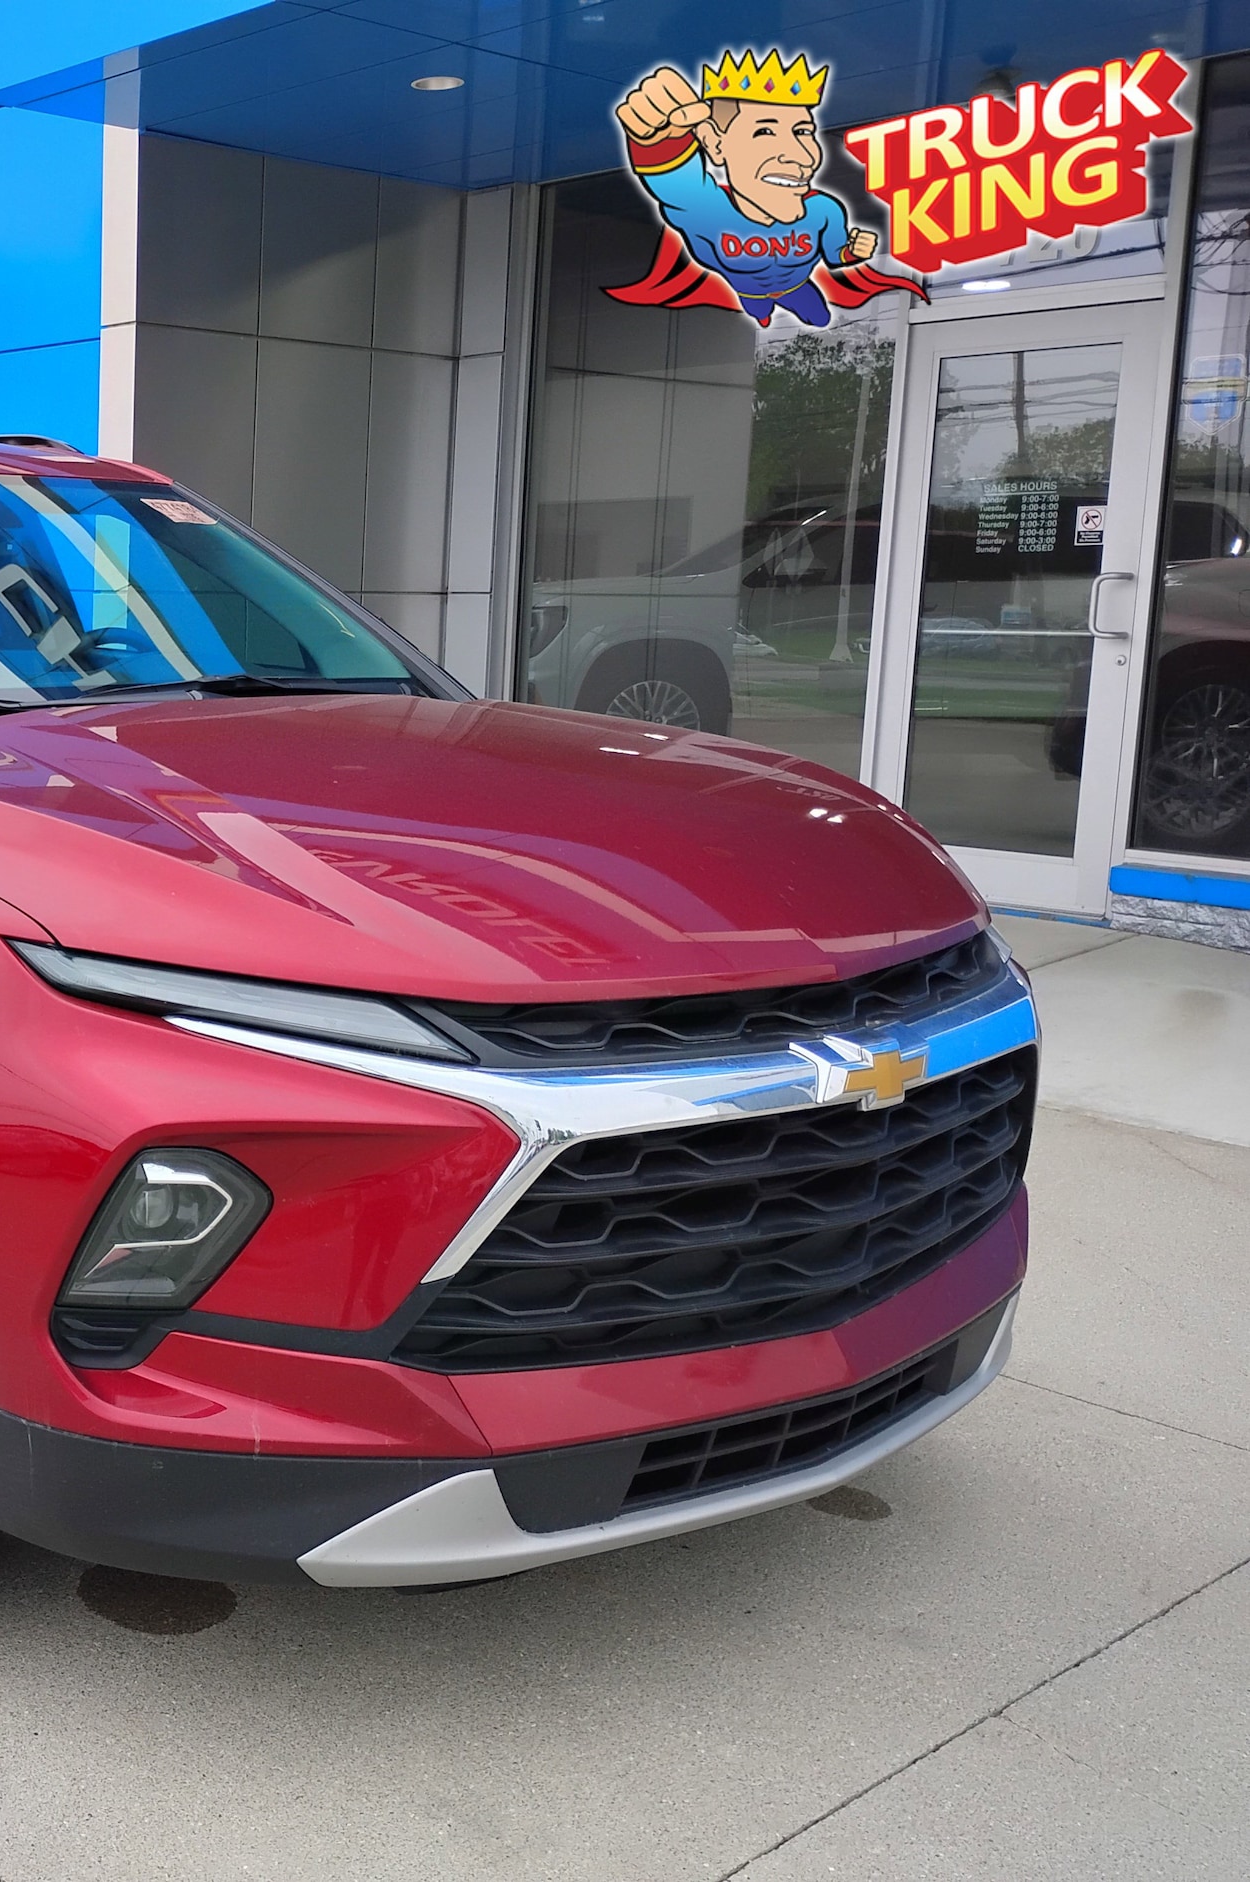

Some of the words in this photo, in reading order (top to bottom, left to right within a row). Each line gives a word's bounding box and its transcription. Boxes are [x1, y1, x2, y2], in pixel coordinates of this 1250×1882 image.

[983, 483, 1018, 493] SALES
[1020, 481, 1058, 491] HOURS
[979, 504, 1008, 512] Tuesday
[978, 512, 1019, 521] Wednesday
[977, 521, 1009, 529] Thursday
[976, 529, 999, 538] Friday
[975, 538, 1007, 546] Saturday
[975, 545, 1002, 555] Sunday
[1017, 544, 1055, 553] CLOSED
